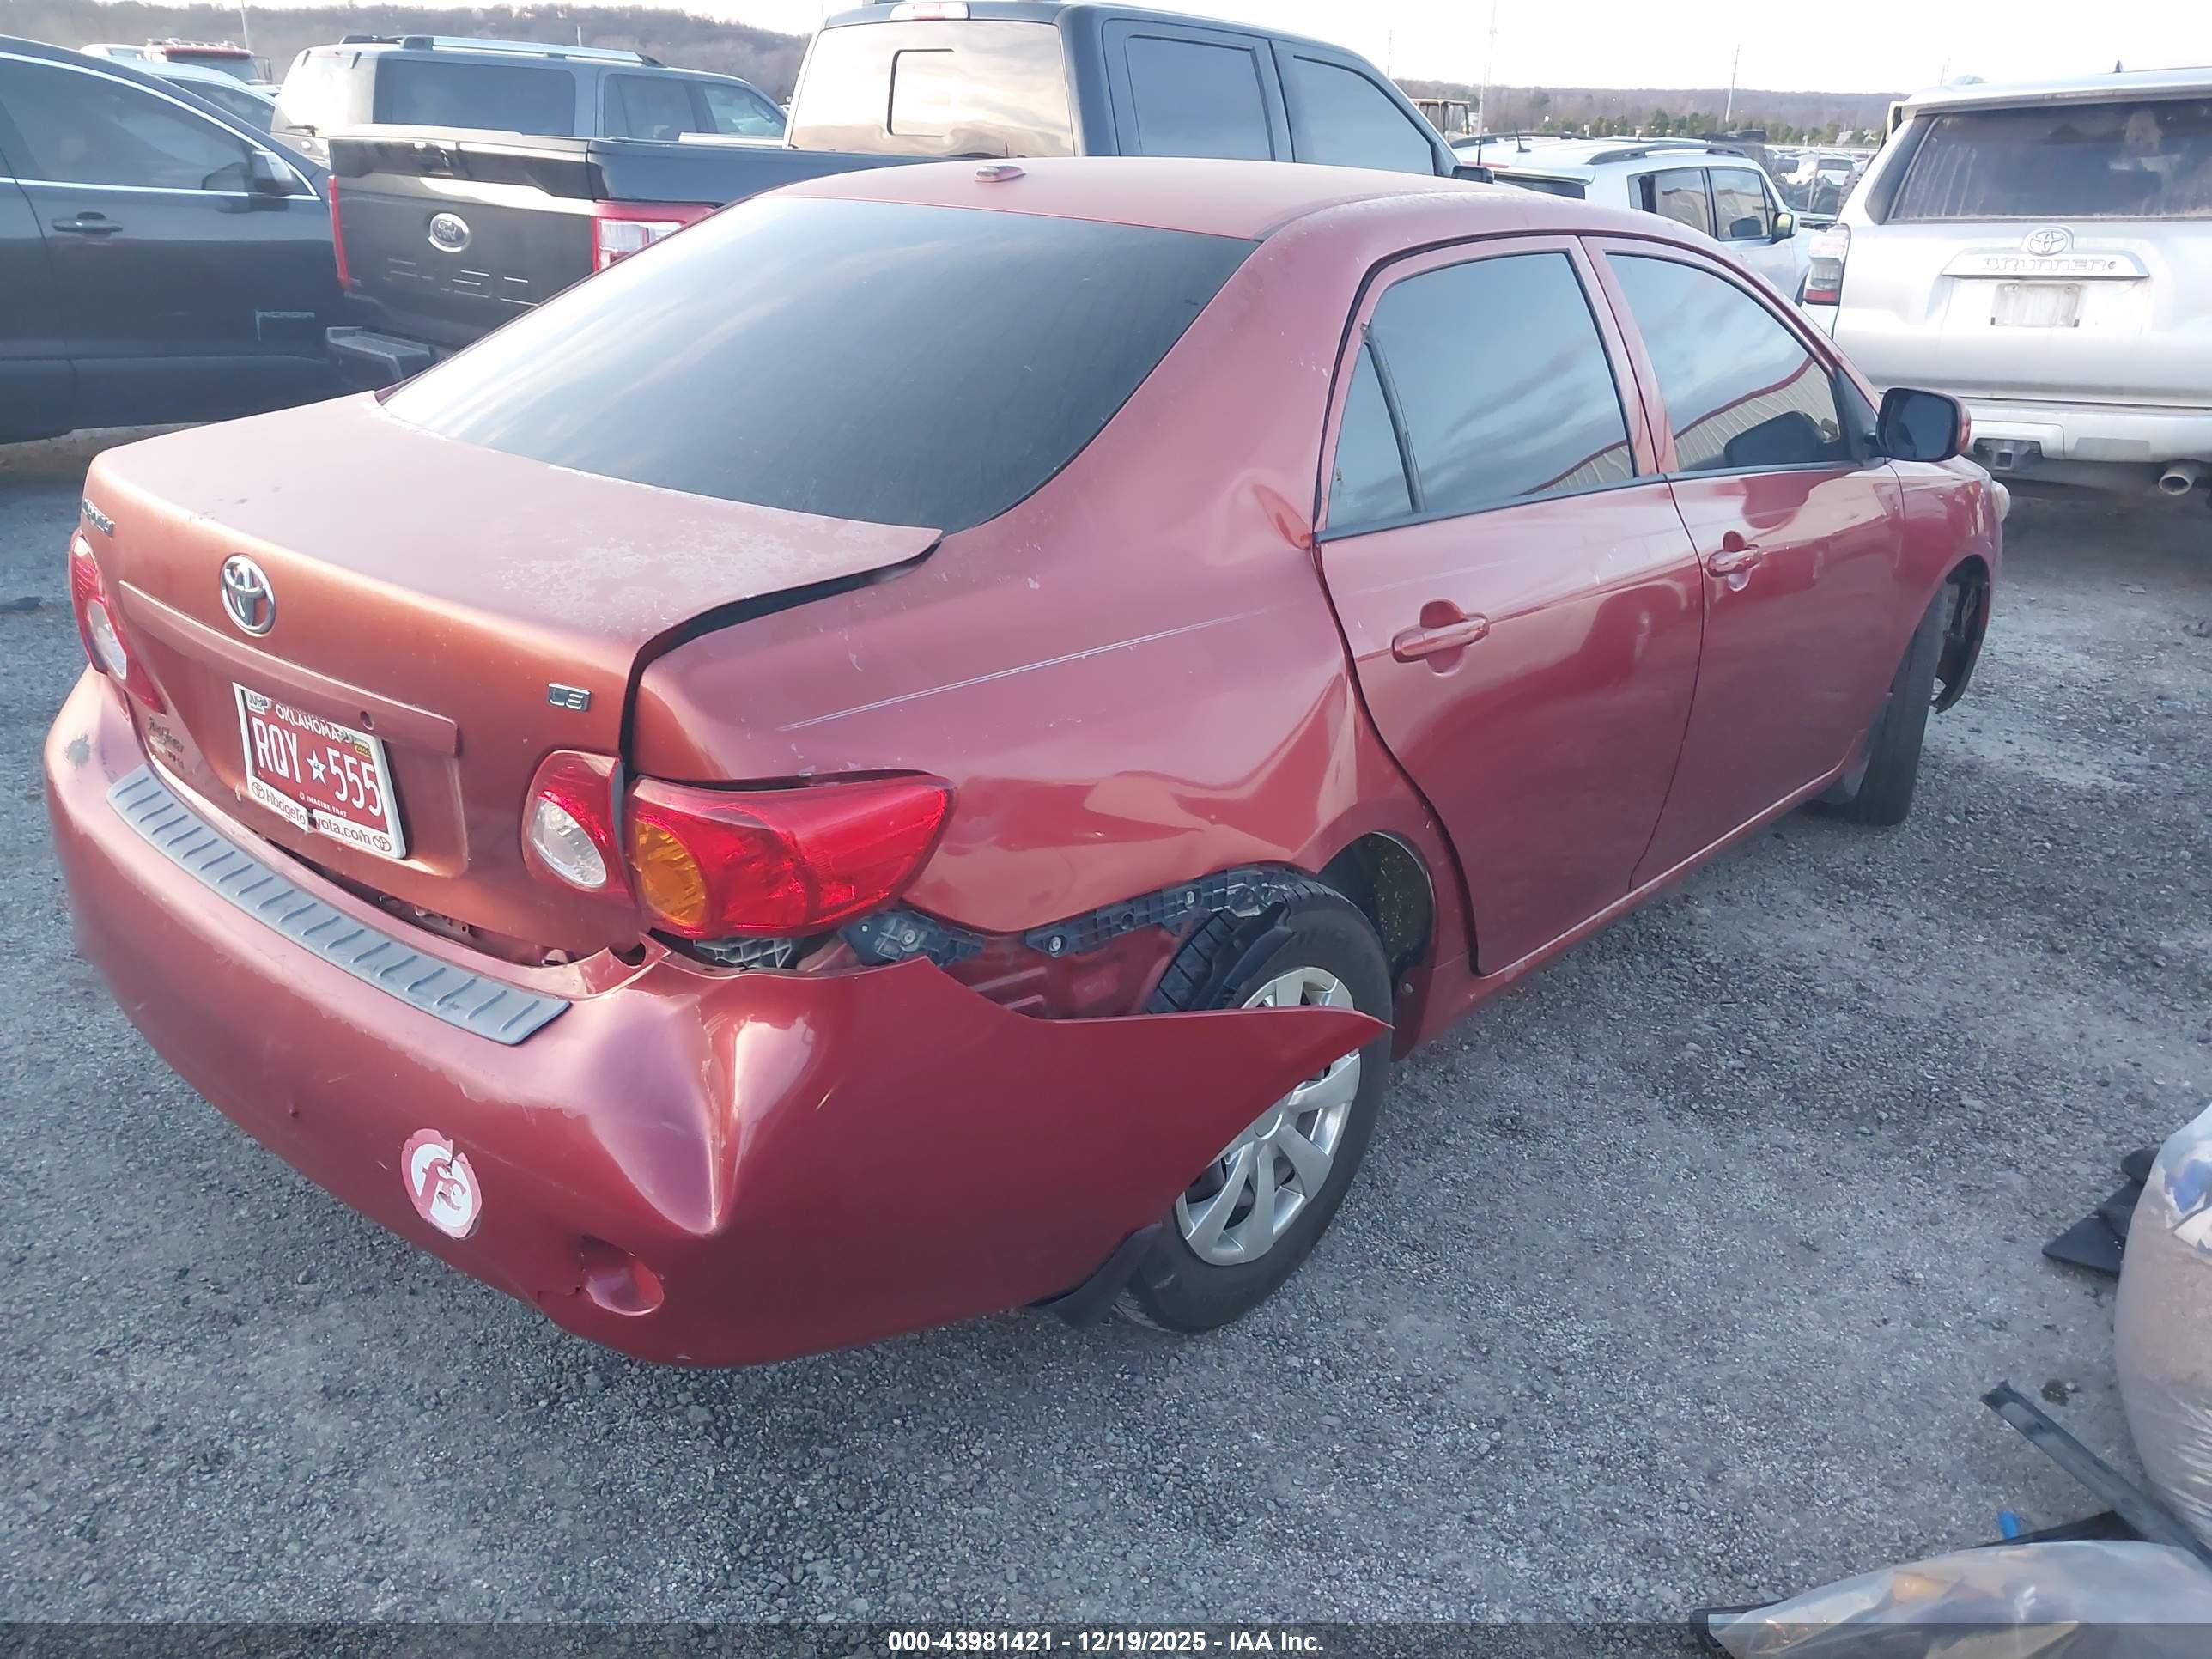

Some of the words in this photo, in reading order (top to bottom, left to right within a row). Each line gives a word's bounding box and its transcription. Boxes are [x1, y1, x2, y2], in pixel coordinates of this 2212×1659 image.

[275, 703, 341, 743] OKLAHOMA
[251, 716, 301, 784] RQY
[326, 746, 382, 817] 555
